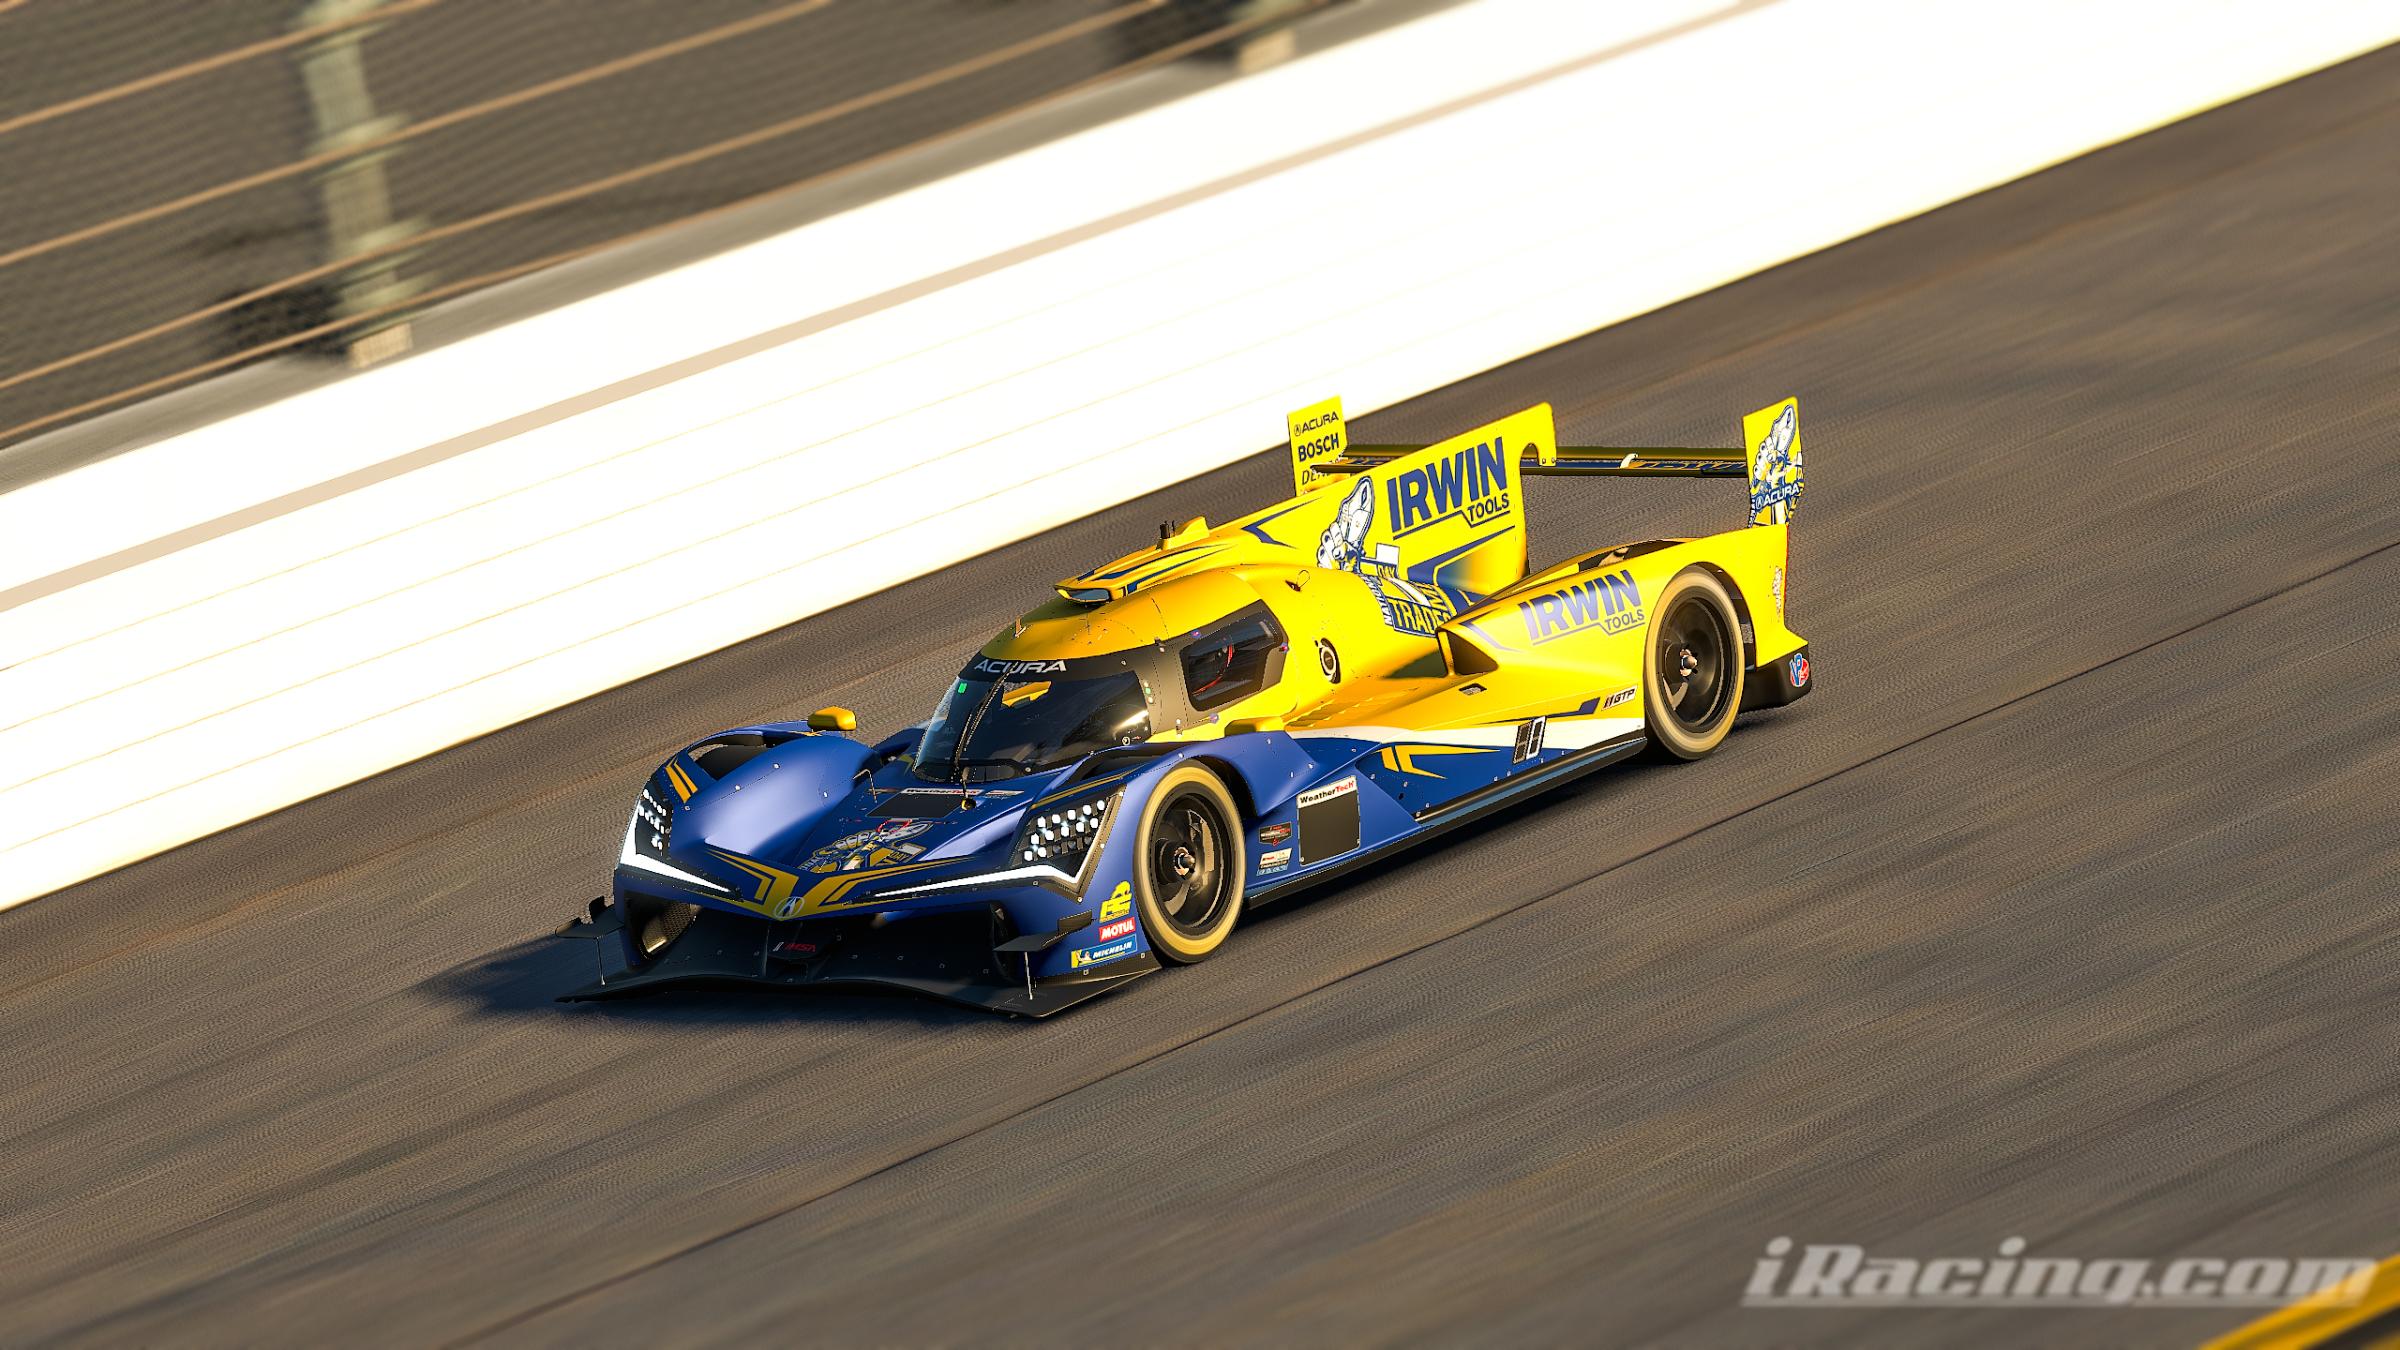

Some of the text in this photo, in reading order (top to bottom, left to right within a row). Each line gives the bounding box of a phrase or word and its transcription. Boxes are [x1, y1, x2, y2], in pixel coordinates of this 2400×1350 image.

[1302, 411, 1339, 433] ACURA
[1298, 432, 1340, 462] BOSCH
[1386, 436, 1508, 533] IRWIN
[1763, 482, 1799, 507] ACURA
[1467, 492, 1510, 522] TOOLS
[1518, 569, 1642, 641] IRWIN
[1604, 608, 1645, 630] TOOLS
[974, 659, 1067, 674] ACURA
[1300, 781, 1355, 804] WeatherTech
[1100, 920, 1135, 940] MOTUL
[1093, 941, 1133, 959] MICHELIN
